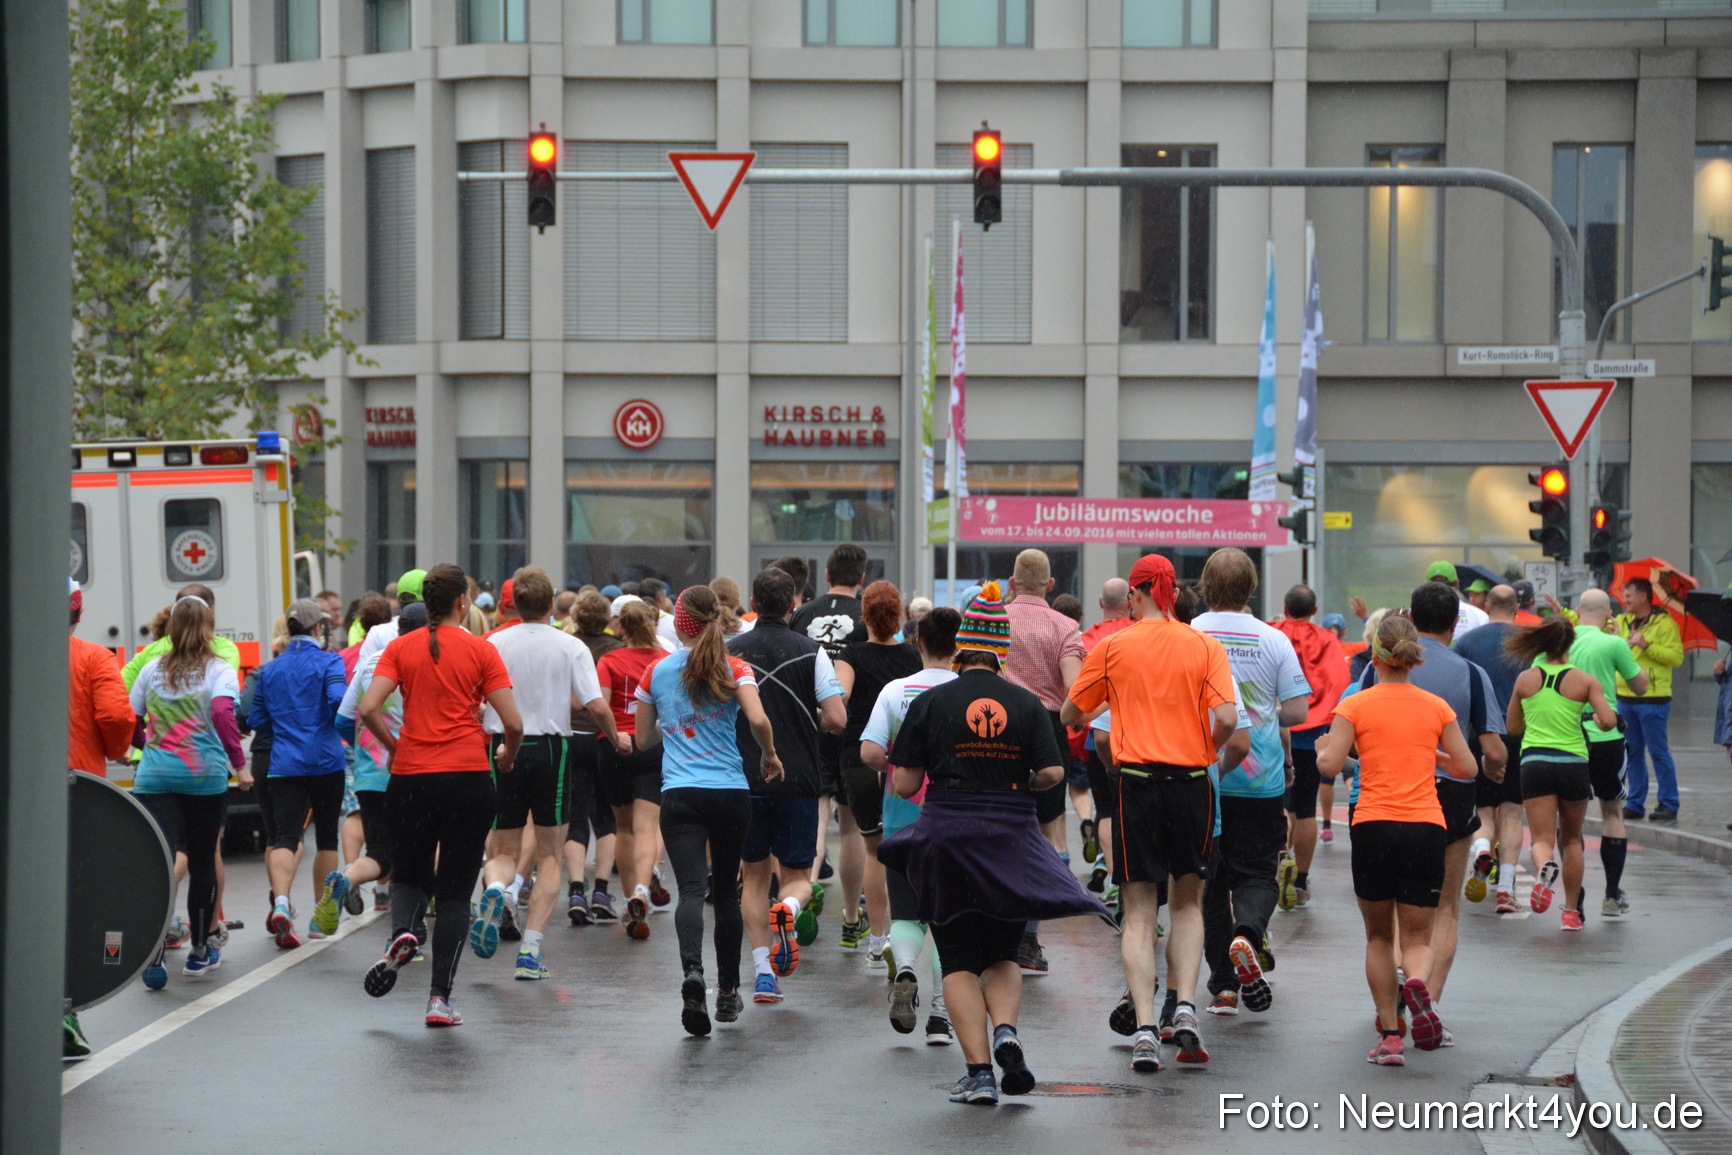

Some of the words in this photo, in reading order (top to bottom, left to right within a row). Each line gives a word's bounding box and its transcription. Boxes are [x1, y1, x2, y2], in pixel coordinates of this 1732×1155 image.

[1463, 349, 1554, 361] Kurt-Romstöck-Ring
[1594, 362, 1649, 374] Dammstraße
[365, 407, 415, 424] KIRSCH
[764, 406, 861, 423] KIRSCH
[871, 406, 885, 423] &
[627, 421, 650, 436] KH
[764, 430, 886, 447] HAUBNER
[1034, 502, 1214, 525] Jubiläumswoche
[981, 527, 1005, 536] vom
[1007, 526, 1024, 536] 17.
[1026, 526, 1044, 537] bis
[1045, 526, 1114, 538] 24.09.2016
[1116, 527, 1135, 538] mit
[1137, 528, 1174, 540] vielen
[1176, 528, 1211, 540] tollen
[1213, 529, 1267, 541] Aktionen
